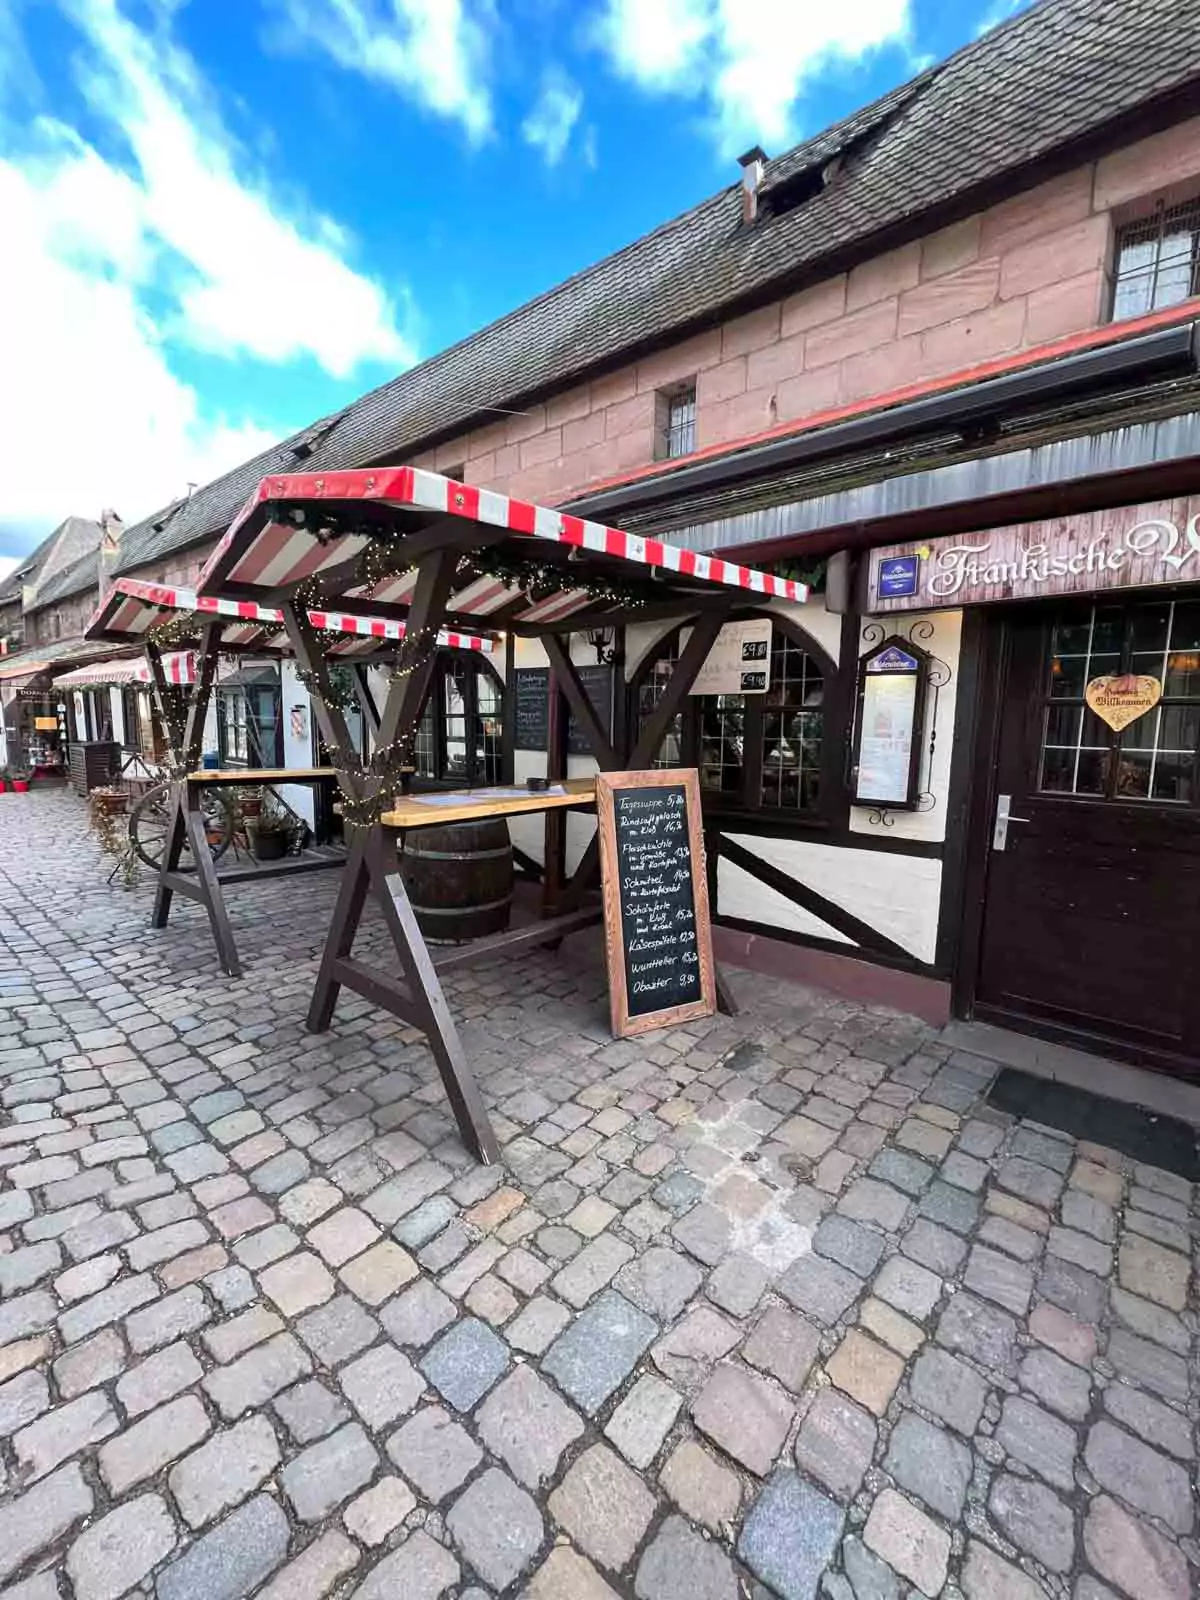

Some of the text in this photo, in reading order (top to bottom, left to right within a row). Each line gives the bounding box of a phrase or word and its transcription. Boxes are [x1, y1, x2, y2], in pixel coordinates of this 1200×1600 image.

[928, 533, 1127, 596] Fränkische
[1095, 696, 1152, 706] Willkommen
[619, 797, 663, 814] Tagessuppe
